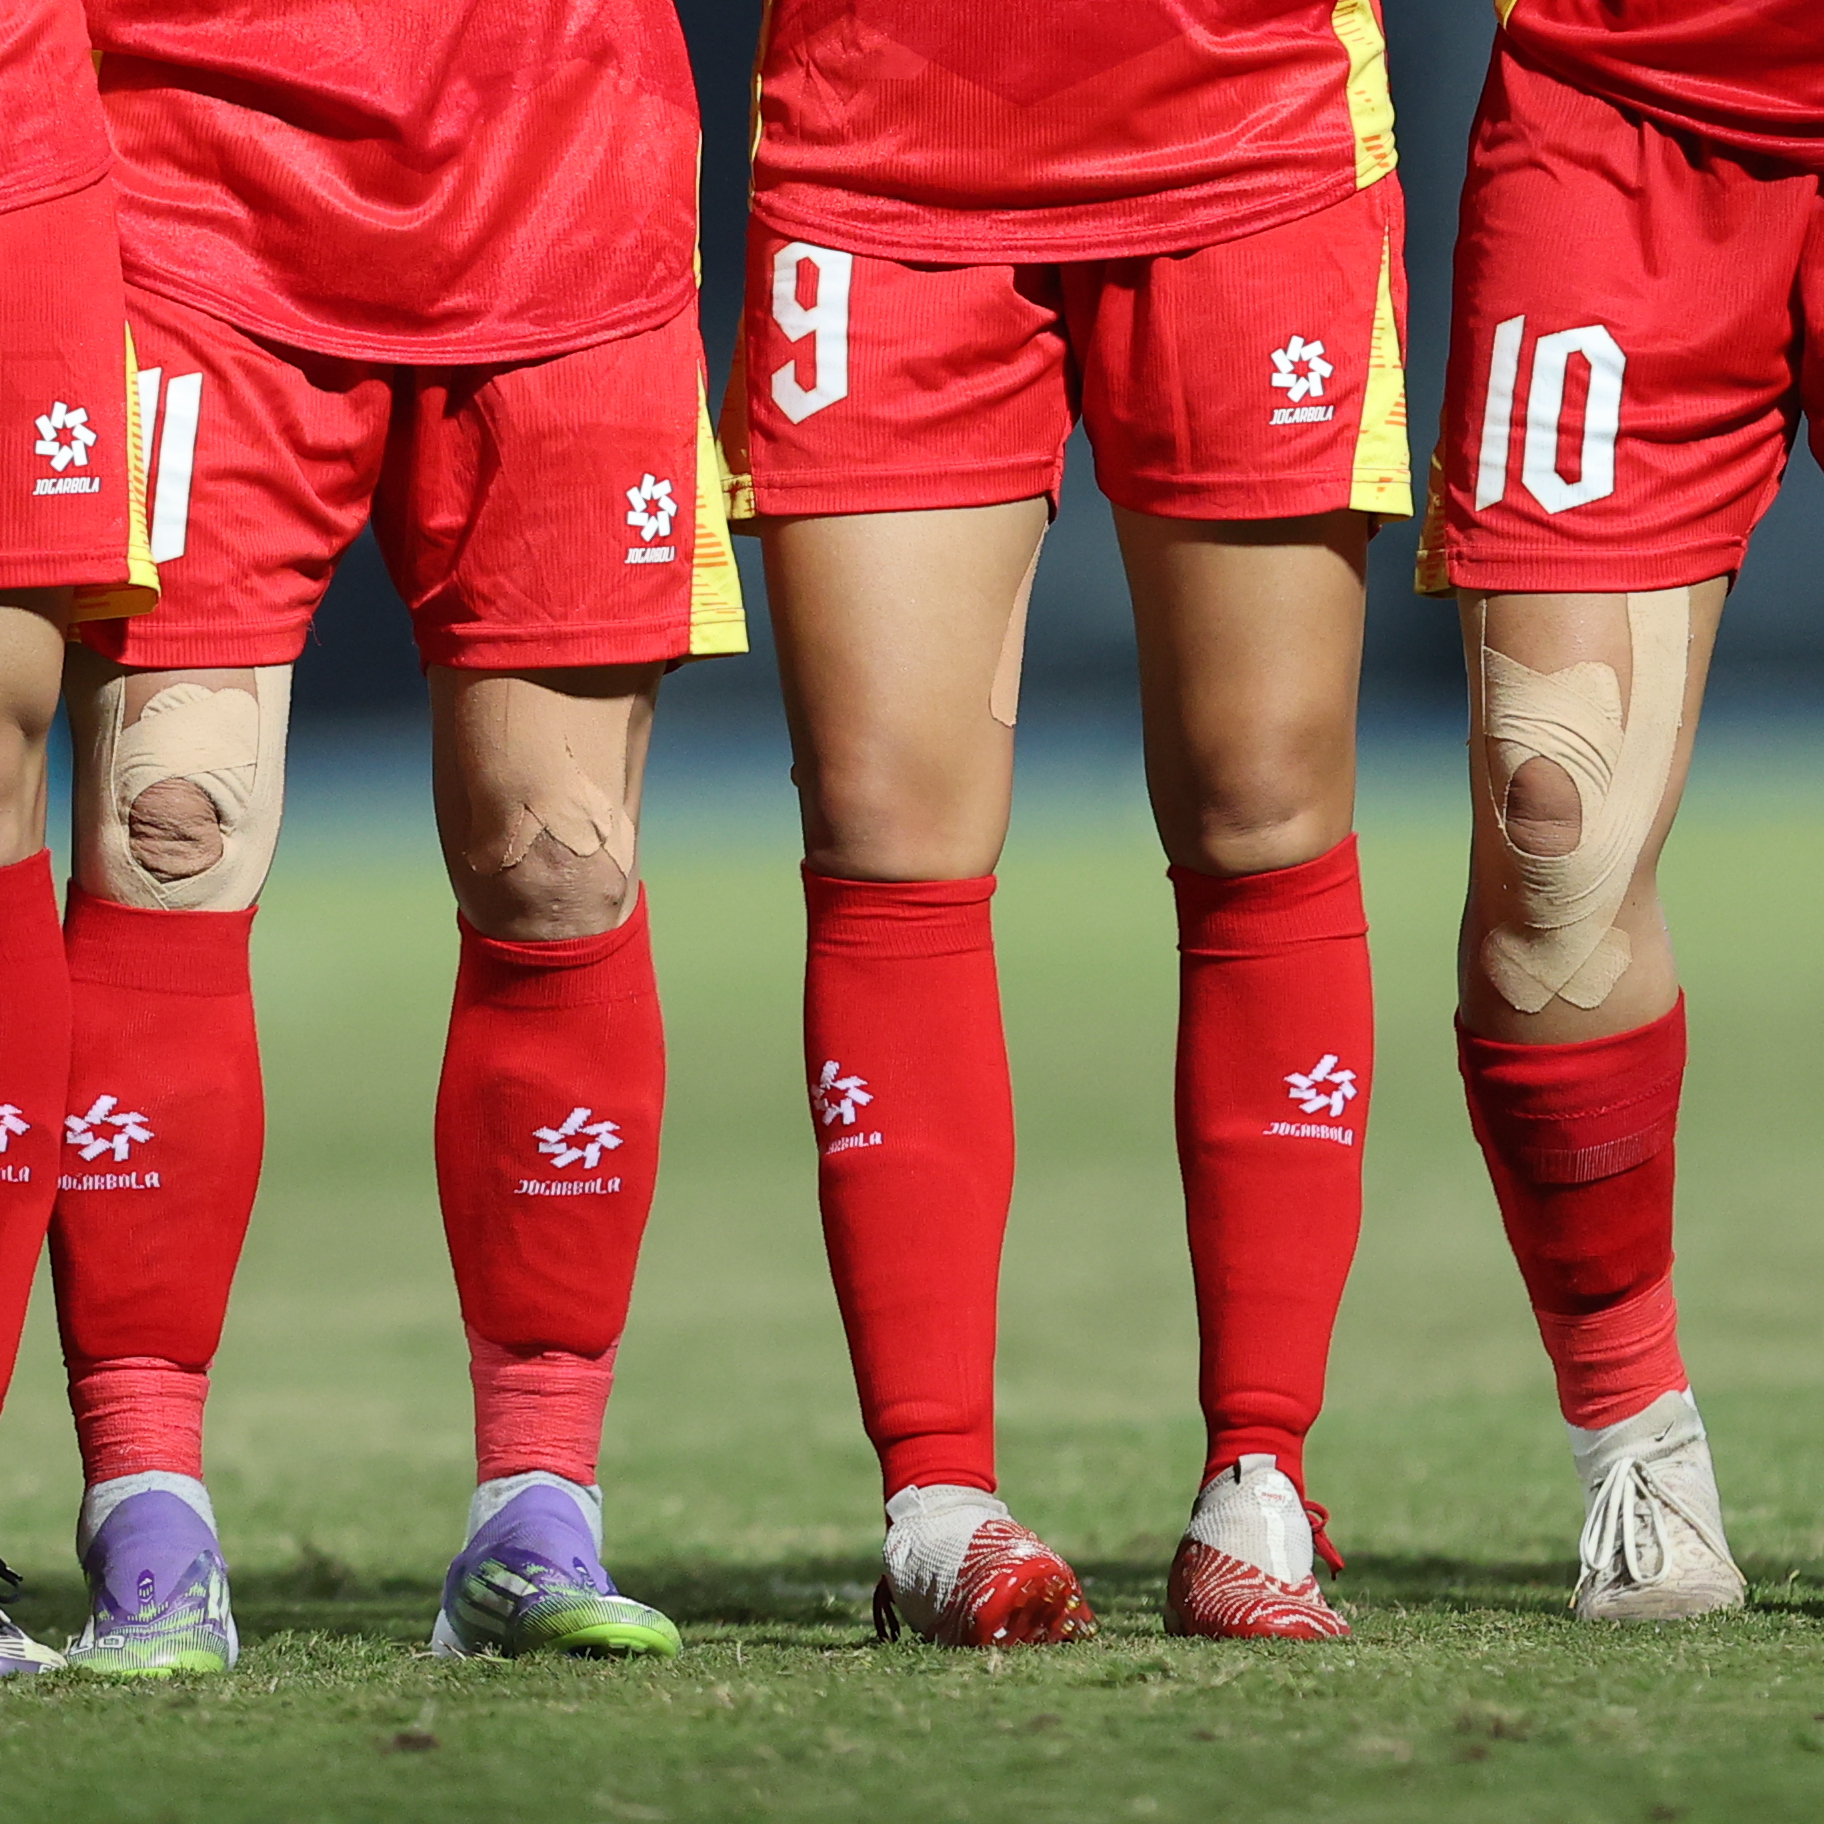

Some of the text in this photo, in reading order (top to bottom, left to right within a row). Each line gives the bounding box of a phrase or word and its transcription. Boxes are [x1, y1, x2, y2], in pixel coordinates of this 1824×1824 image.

[770, 240, 855, 426] 9
[1268, 404, 1335, 426] JOGARBOLA
[1474, 313, 1628, 516] 10
[31, 476, 101, 496] JOGARBOLA
